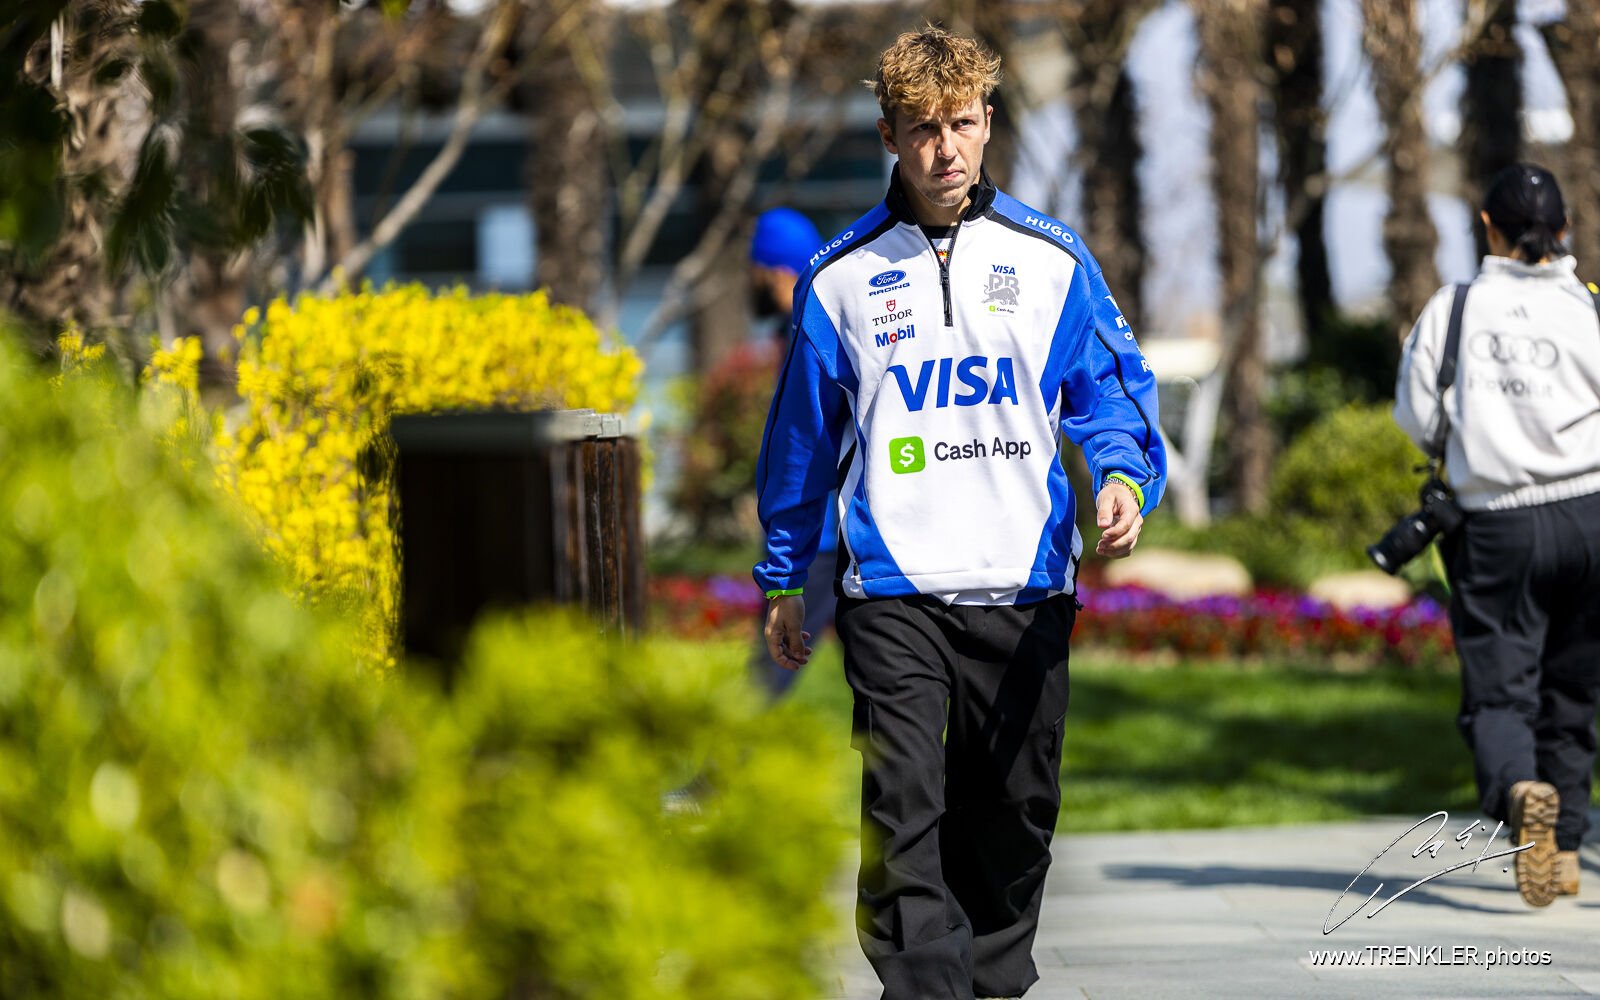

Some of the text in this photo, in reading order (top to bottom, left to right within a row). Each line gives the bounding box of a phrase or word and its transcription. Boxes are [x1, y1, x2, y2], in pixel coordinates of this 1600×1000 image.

[1024, 215, 1074, 244] HUGO
[809, 230, 854, 266] HUGO
[876, 272, 899, 286] Ford
[991, 264, 1016, 275] VISA
[868, 282, 910, 296] RACING
[872, 308, 913, 326] TUDOR
[874, 324, 916, 348] Mobil
[886, 355, 1019, 412] VISA
[934, 438, 987, 462] Cash
[991, 436, 1032, 460] App
